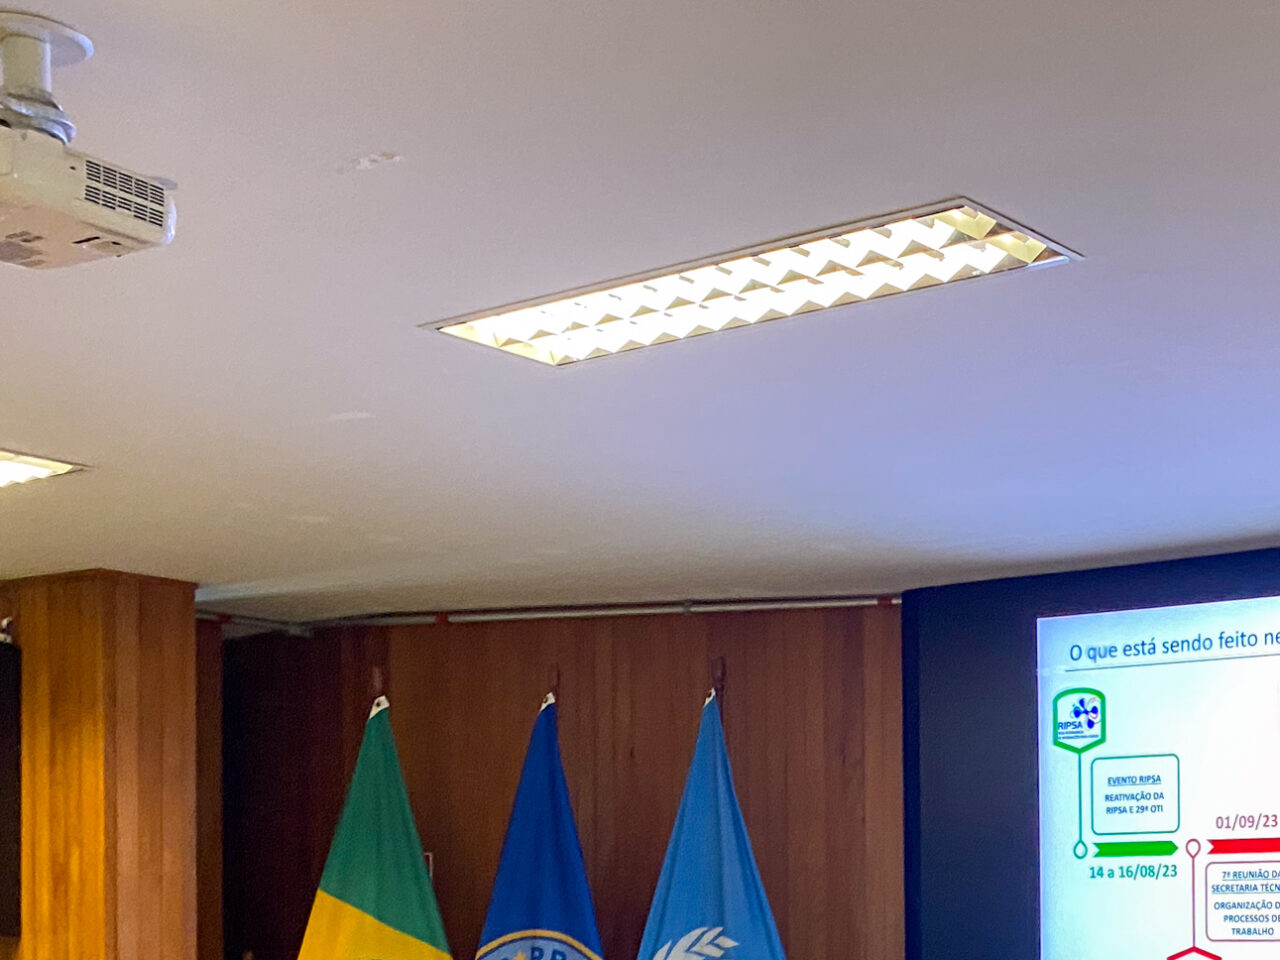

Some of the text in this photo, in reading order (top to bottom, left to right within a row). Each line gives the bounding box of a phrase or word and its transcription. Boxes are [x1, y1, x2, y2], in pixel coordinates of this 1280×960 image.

[1070, 644, 1082, 661] O
[1088, 644, 1118, 664] que
[1122, 637, 1156, 658] está
[1162, 633, 1213, 654] sendo
[1218, 629, 1258, 650] feito
[1058, 721, 1084, 730] RIPSA
[1108, 774, 1162, 786] EVENTO RIPSA
[1105, 791, 1164, 802] REATIVAÇÃO DA
[1106, 805, 1127, 814] RIPSA
[1129, 806, 1134, 814] E
[1150, 804, 1164, 814] OTI
[1216, 813, 1278, 832] 01/09/23
[1089, 864, 1178, 880] 14 a 16/08/23
[1232, 869, 1270, 880] REUNIÃO
[1211, 883, 1258, 893] SECRETARIA
[1214, 899, 1273, 912] ORGANIZAÇÃO
[1224, 914, 1270, 923] PROCESSOS
[1232, 927, 1274, 936] TRABALHO
